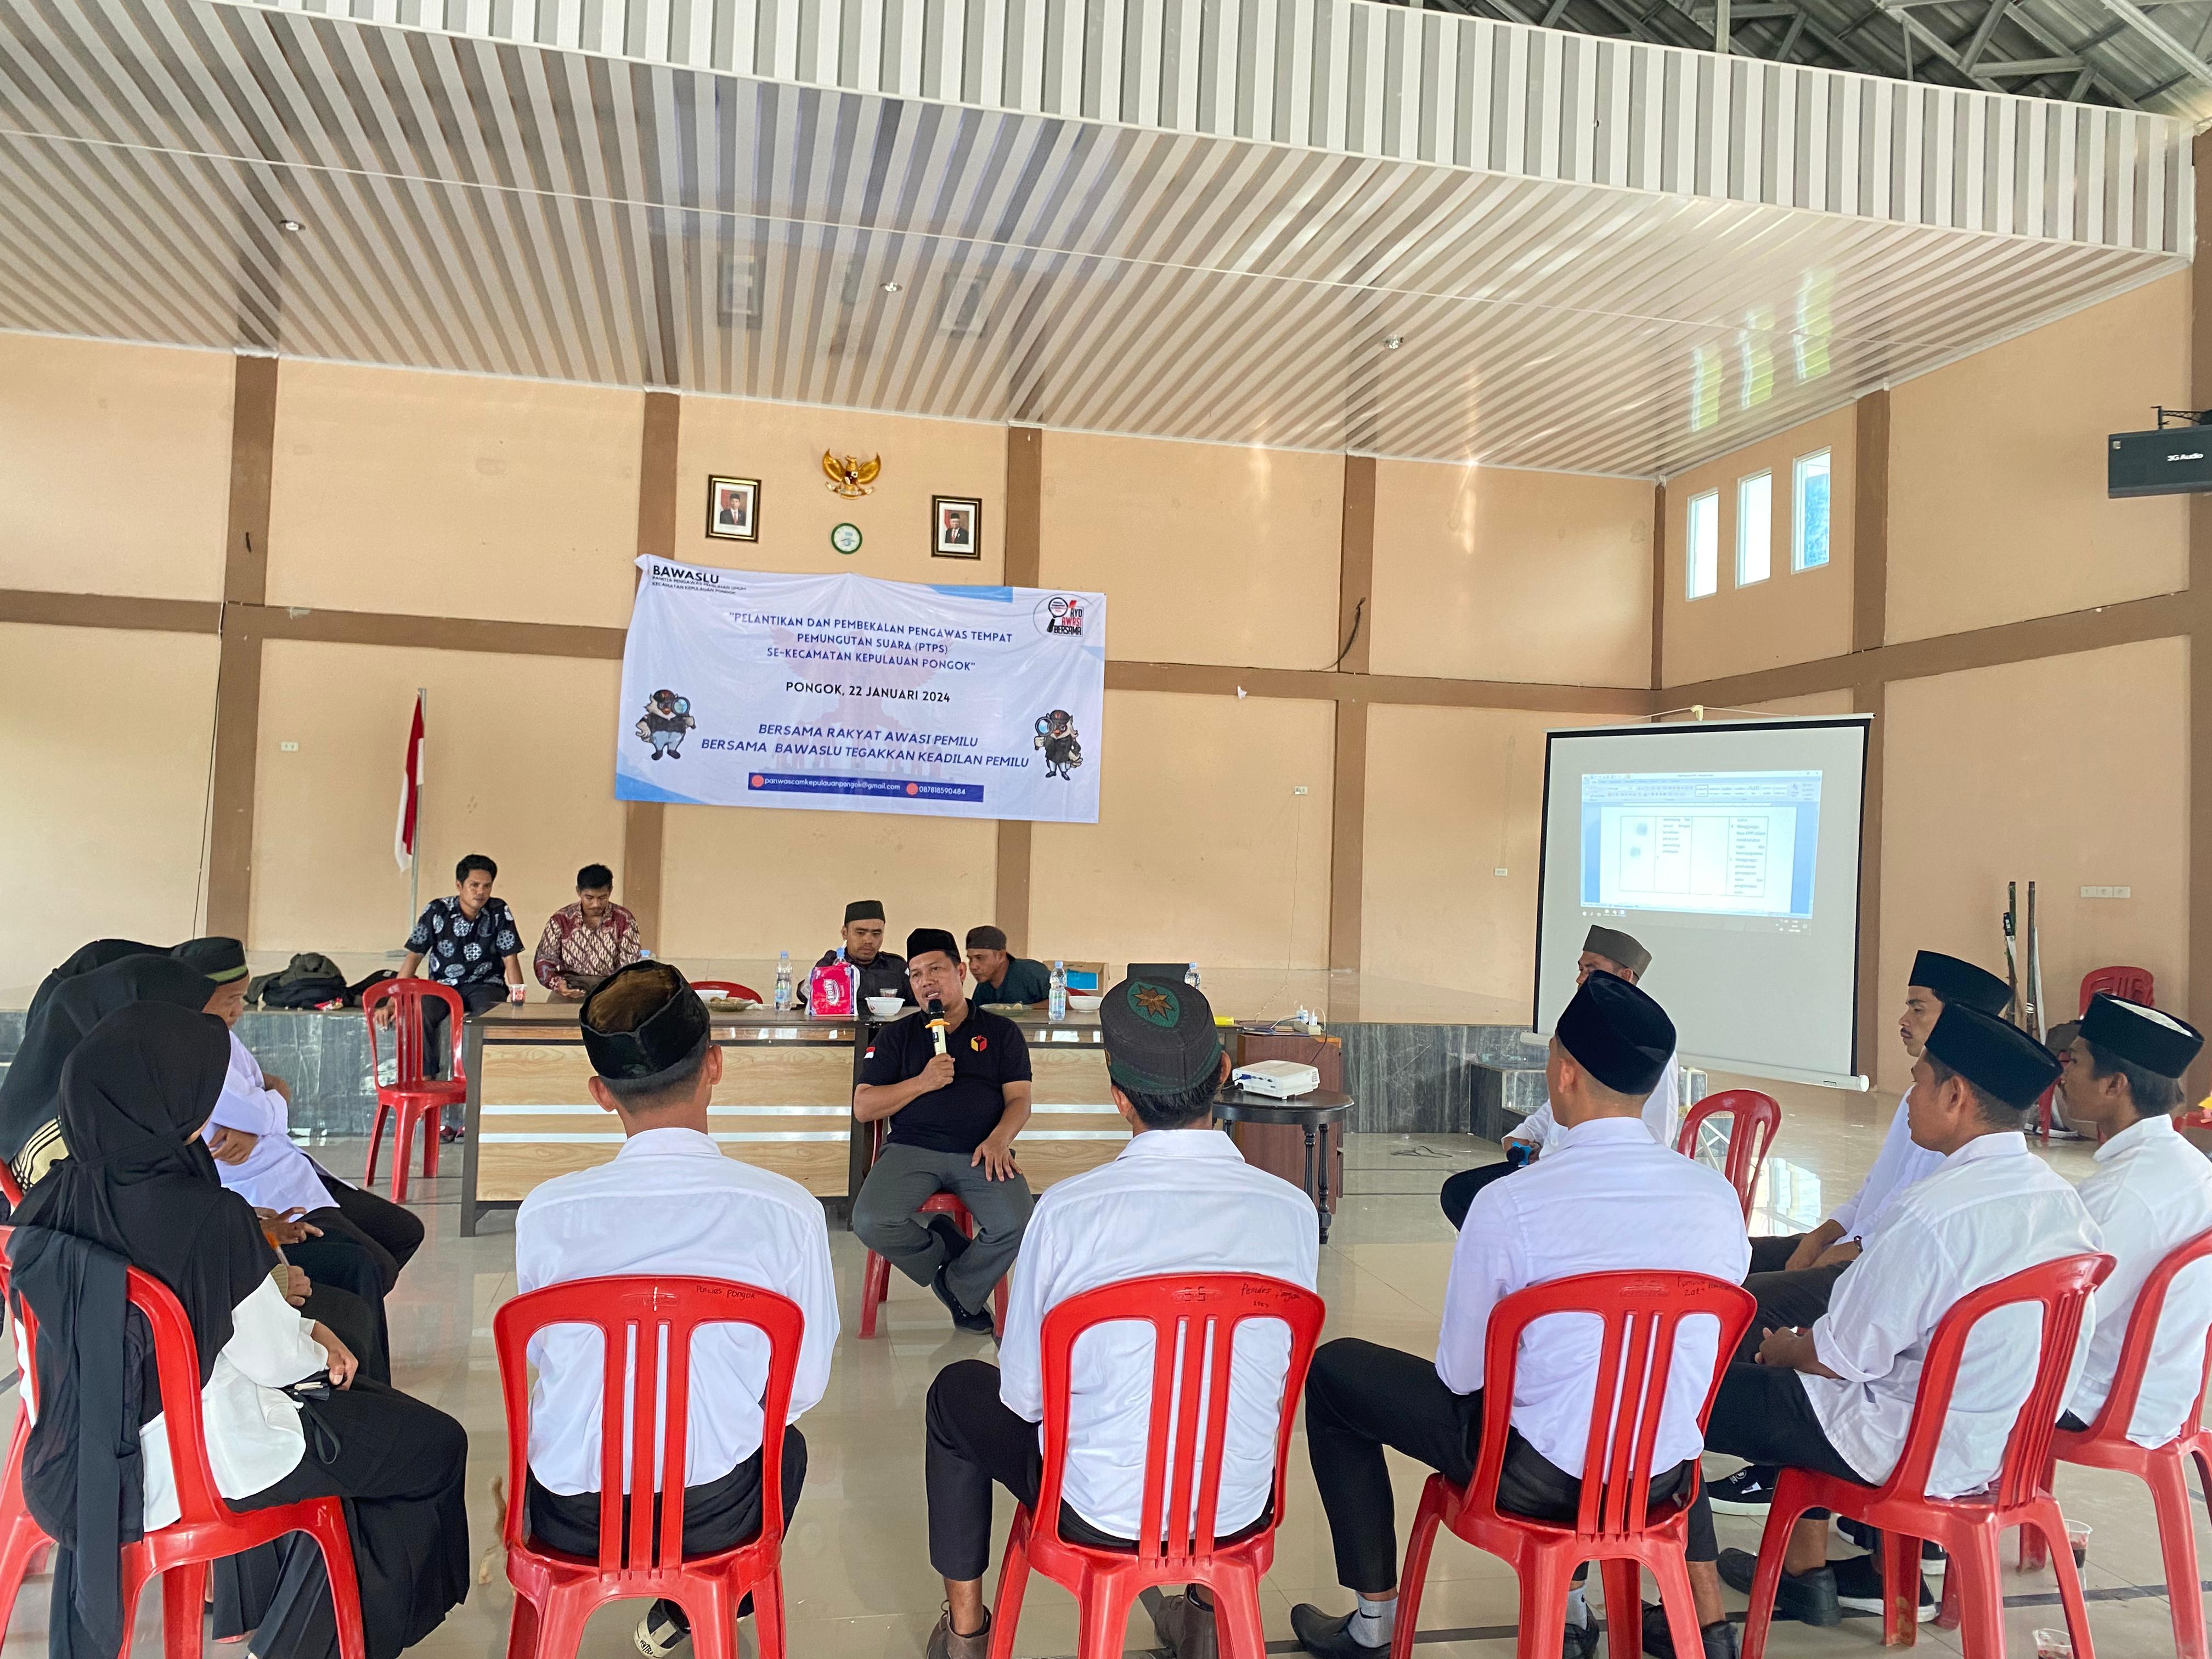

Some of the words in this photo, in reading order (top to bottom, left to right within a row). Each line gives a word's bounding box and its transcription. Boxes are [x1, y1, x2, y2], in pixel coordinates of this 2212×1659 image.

[653, 565, 719, 584] BAWASLU
[1062, 617, 1082, 627] AWASI
[1070, 608, 1082, 618] AYO
[729, 612, 803, 626] "PELANTIKAN
[807, 618, 831, 627] DAN
[834, 619, 905, 634] PEMBEKALAN
[909, 626, 968, 639] PENGAWAS
[971, 631, 1013, 642] TEMPAT
[1054, 625, 1081, 635] BERSAMA
[797, 633, 872, 646] PEMUNGUTAN
[876, 639, 911, 651] SUARA
[915, 642, 949, 654] (PTPS)
[767, 647, 851, 661] SE-KECAMATAN
[855, 652, 918, 667] KEPULAUAN
[922, 659, 975, 671] PONGOK"
[786, 681, 845, 696] PONGOK,
[849, 686, 862, 696] 22
[866, 686, 918, 701] JANUARI
[922, 691, 950, 703] 2024
[759, 724, 823, 738] BERSAMA
[827, 727, 882, 741] RAKYAT
[884, 731, 931, 744] AWASI
[934, 735, 979, 747] PEMILU
[701, 739, 768, 753] BERSAMA
[775, 743, 843, 756] BAWASLU
[845, 746, 916, 761] TEGAKKAN
[918, 751, 983, 765] KEADILAN
[985, 755, 1029, 768] PEMILU
[919, 786, 966, 795] 087818590484
